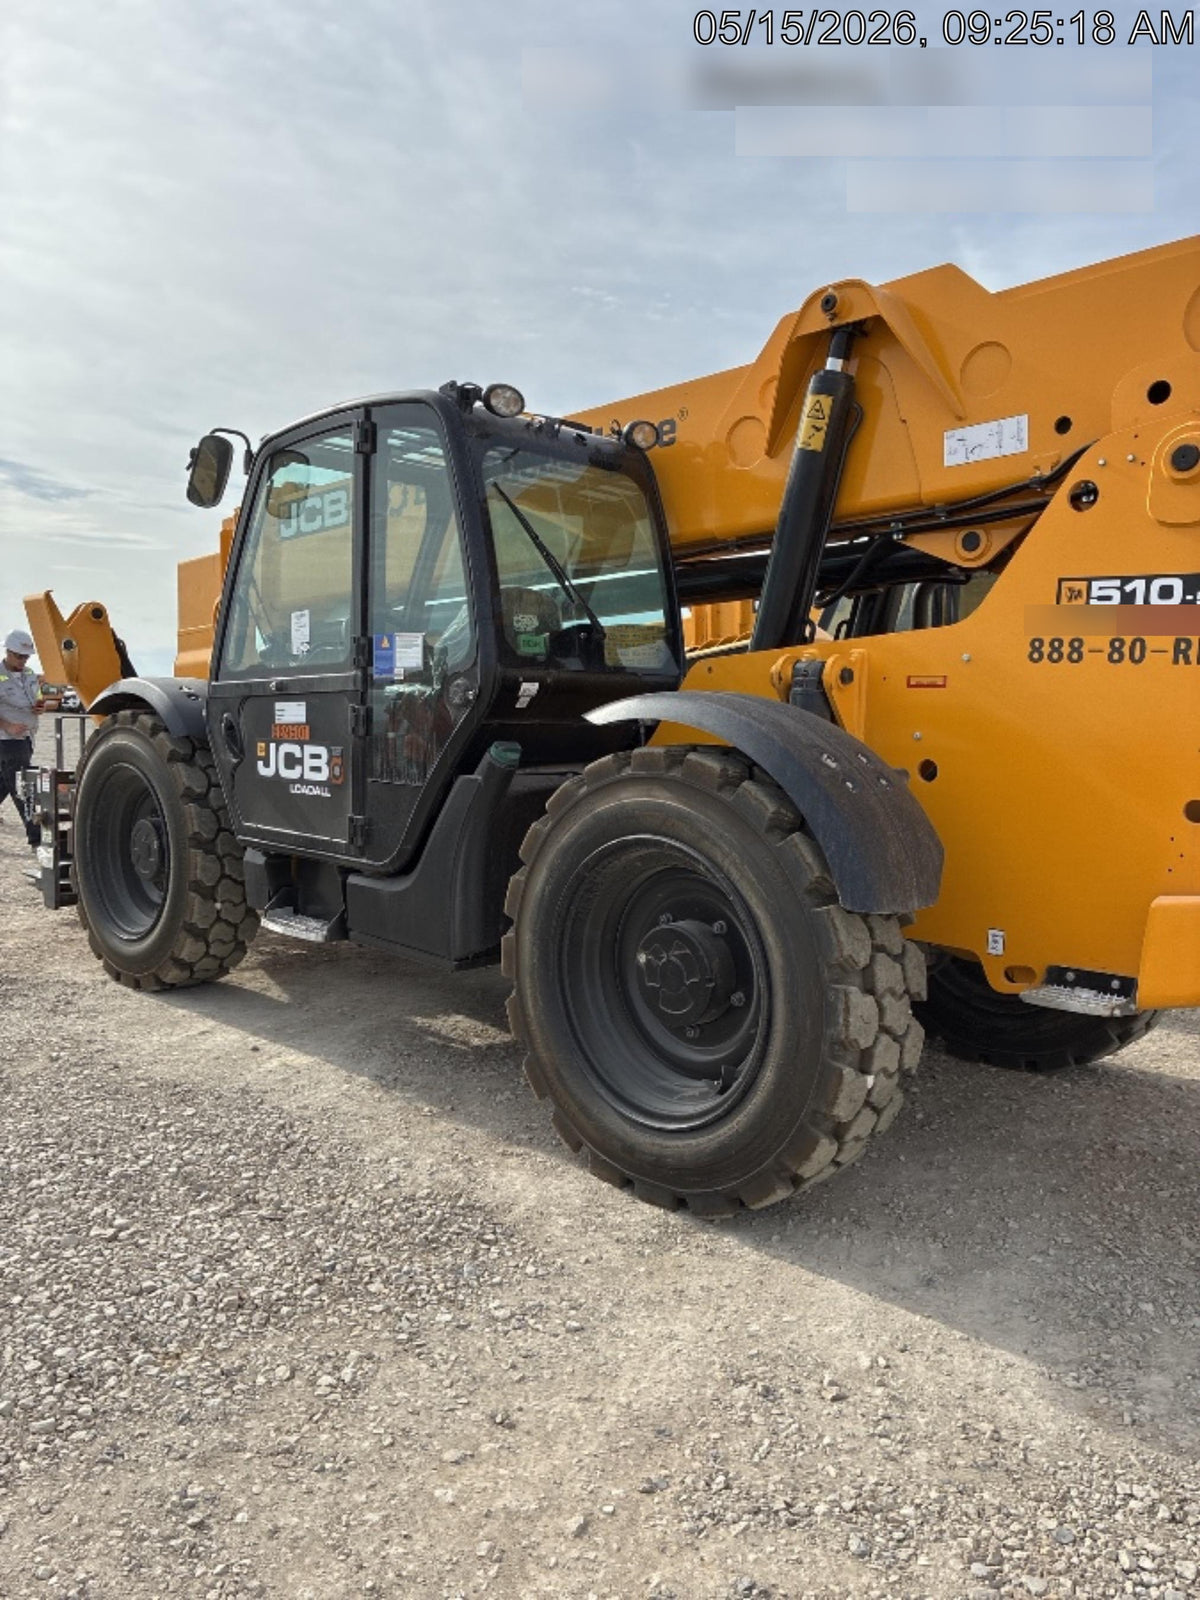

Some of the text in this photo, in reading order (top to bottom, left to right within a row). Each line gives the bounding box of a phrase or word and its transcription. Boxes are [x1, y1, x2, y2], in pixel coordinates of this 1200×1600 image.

[280, 489, 348, 538] JCB
[1028, 636, 1200, 666] 888-80-R
[257, 742, 330, 782] JCB
[289, 783, 332, 798] LOADALL
